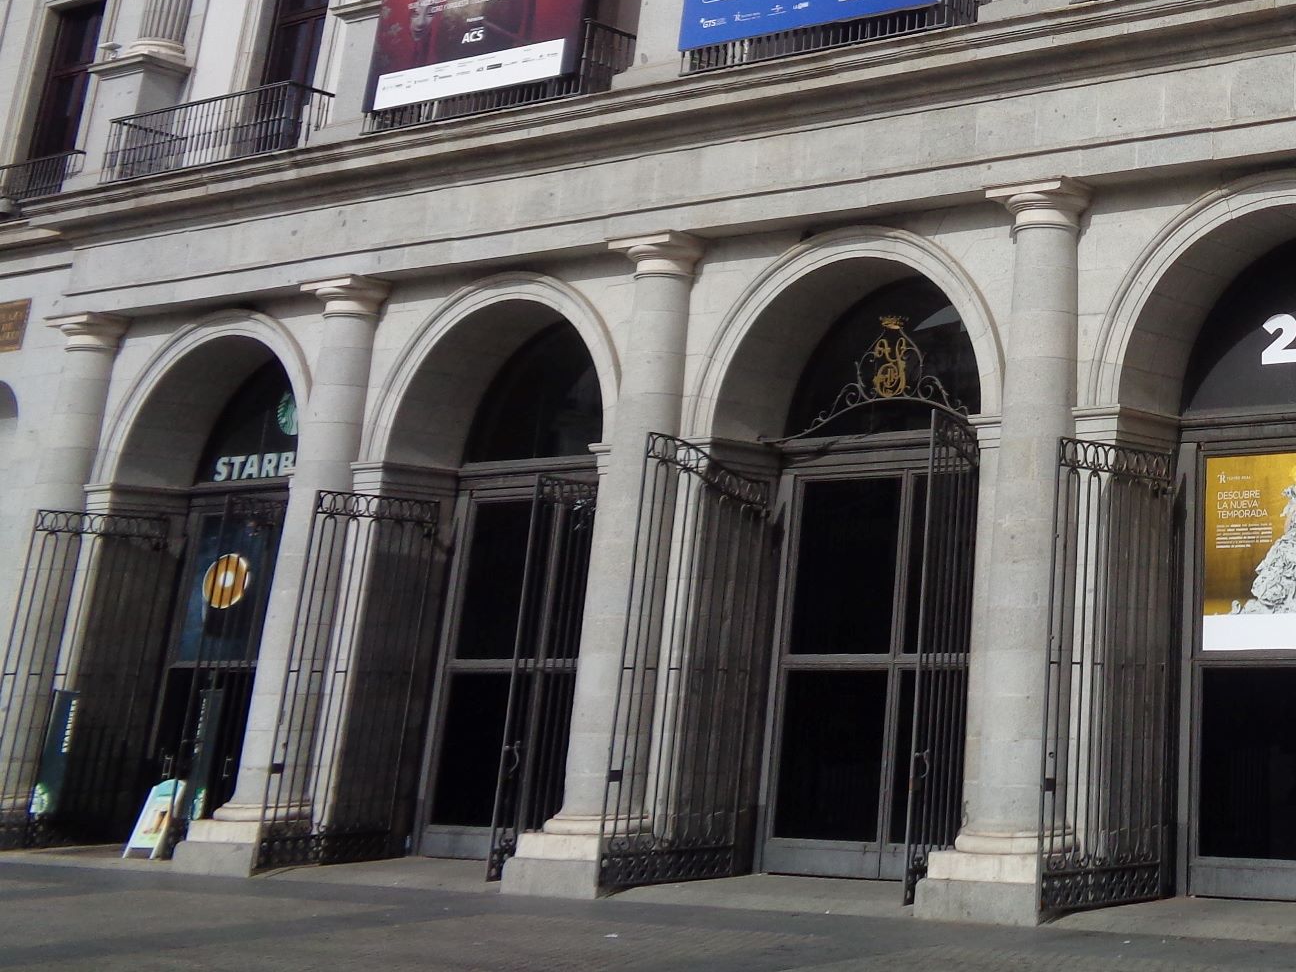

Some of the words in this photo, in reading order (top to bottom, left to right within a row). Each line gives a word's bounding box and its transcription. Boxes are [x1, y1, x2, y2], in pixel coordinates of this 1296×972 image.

[461, 30, 484, 44] ACS
[213, 451, 296, 482] STARB
[1217, 490, 1260, 500] DESCUBRE
[1217, 501, 1229, 509] LA
[1230, 500, 1259, 509] NUEVA
[1217, 509, 1268, 519] TEMPORADA
